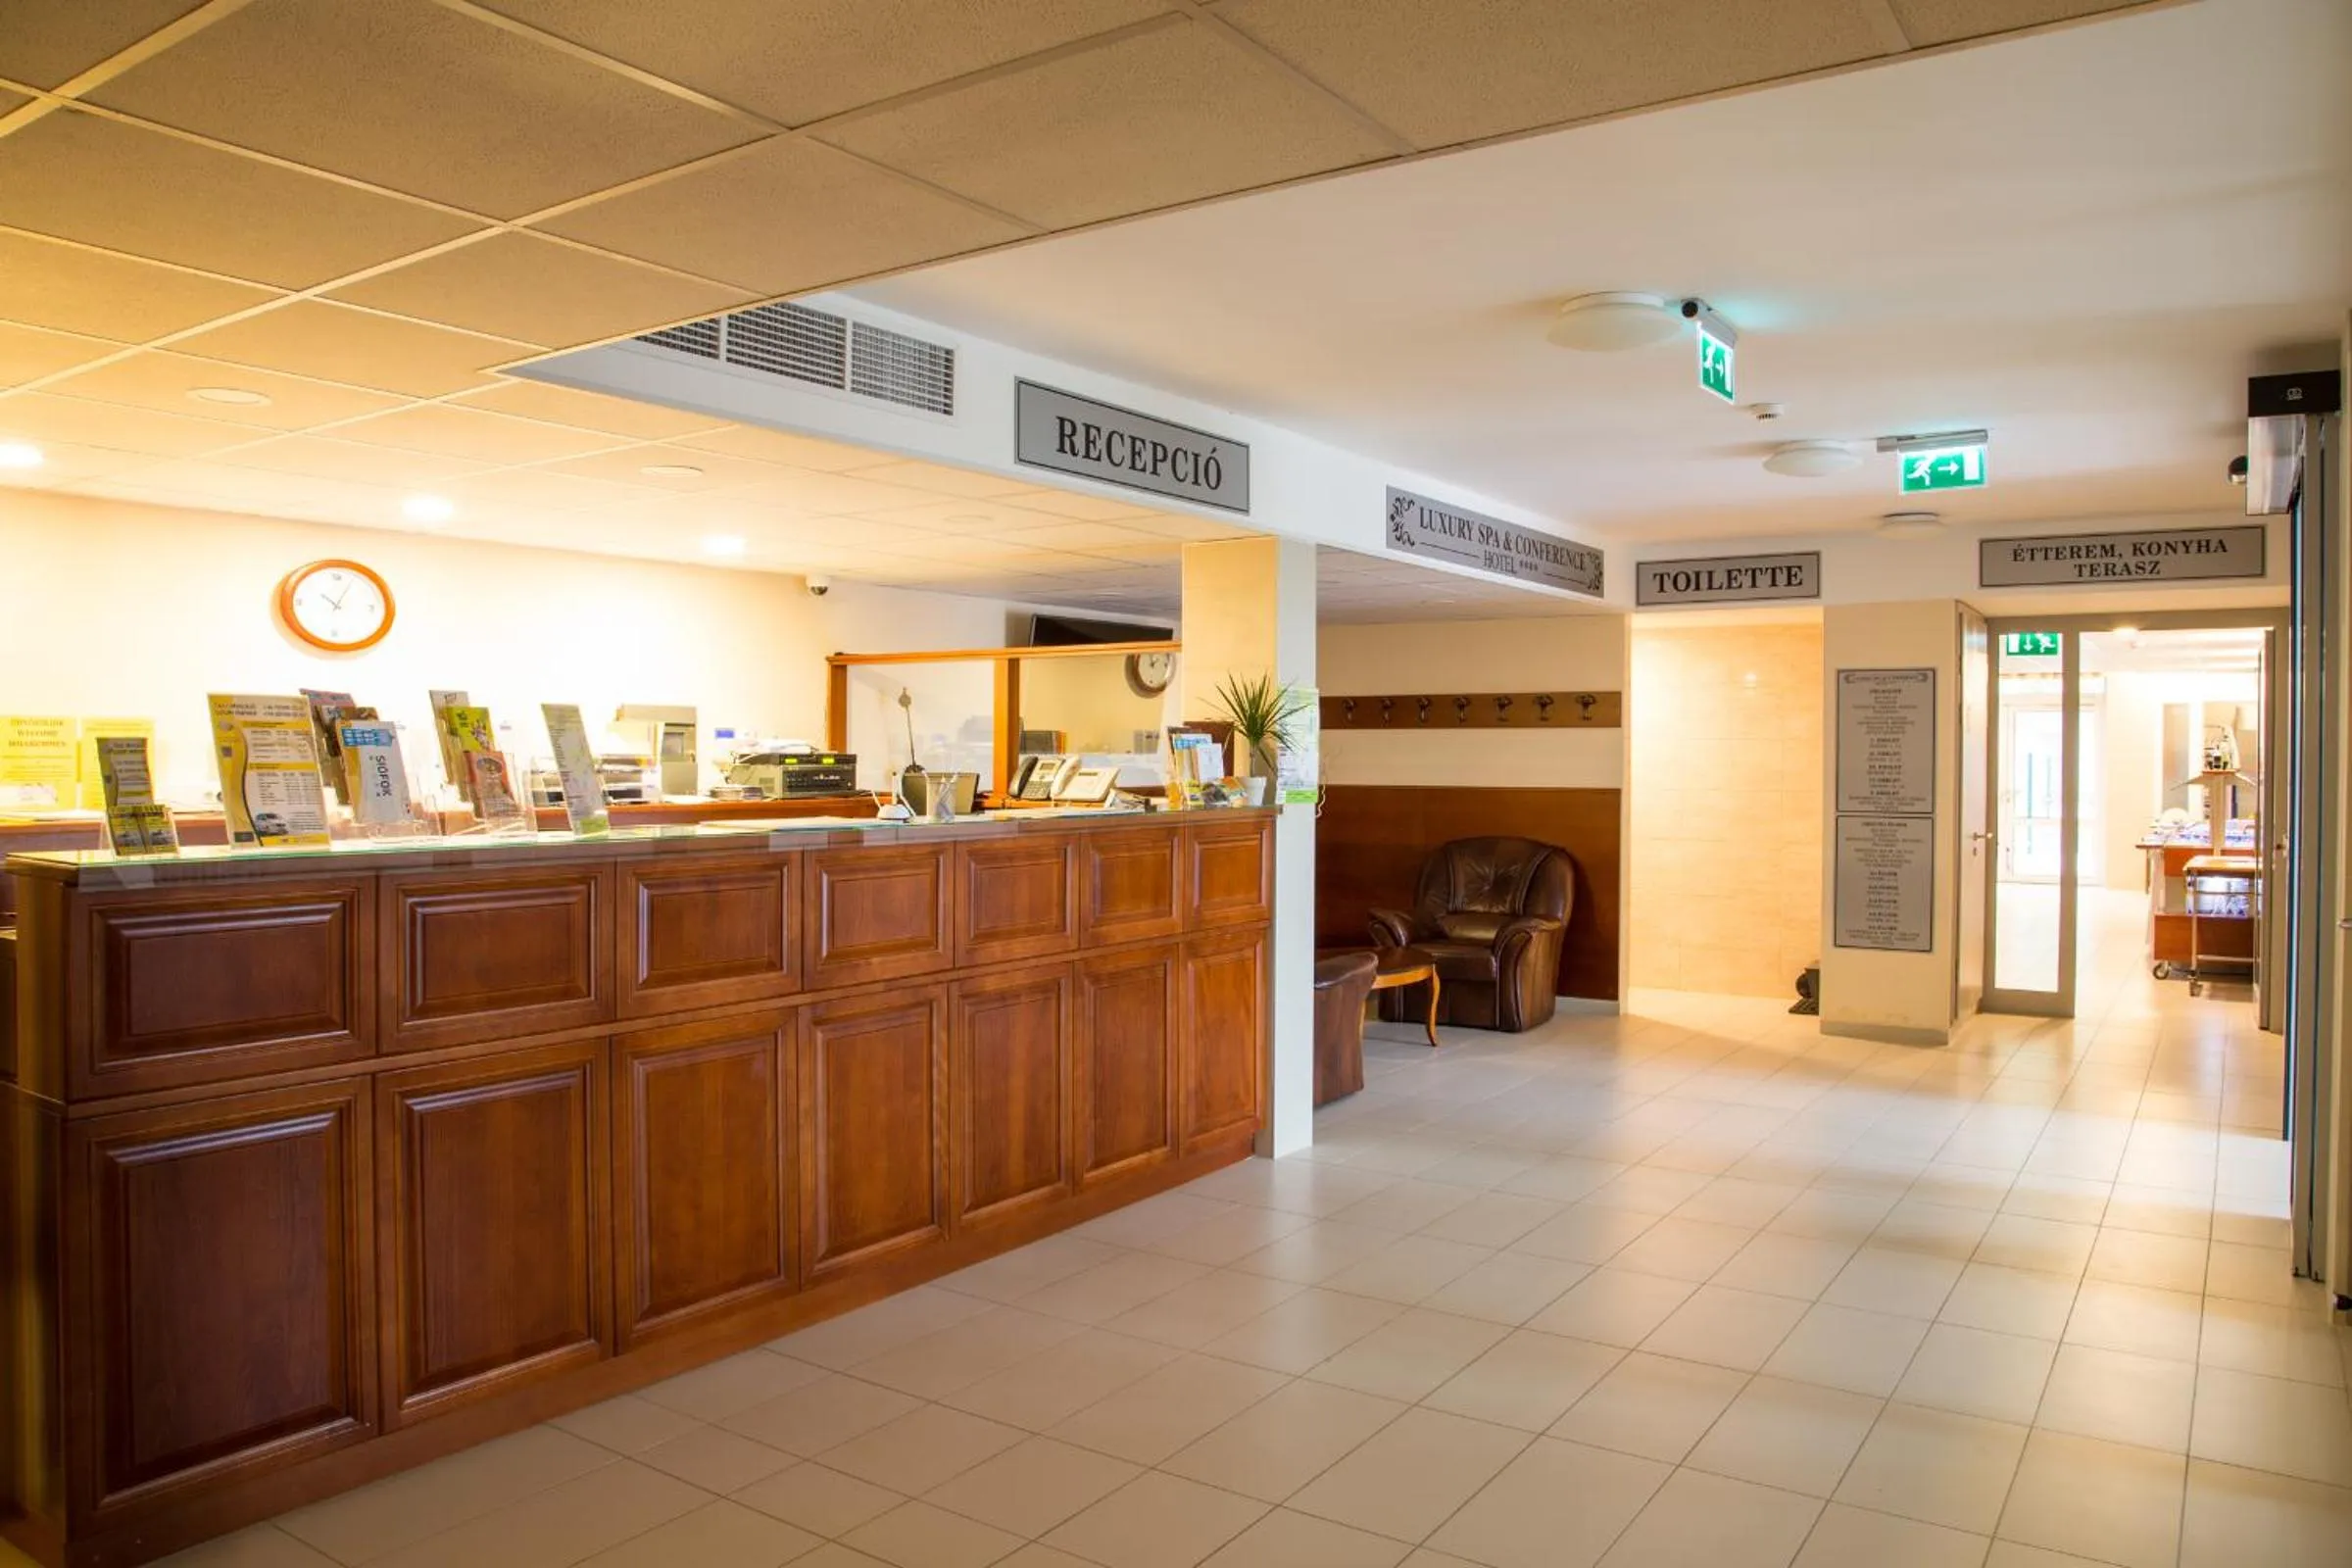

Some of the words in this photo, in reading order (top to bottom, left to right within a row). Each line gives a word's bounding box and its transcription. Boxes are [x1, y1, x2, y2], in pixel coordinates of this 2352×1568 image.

[1054, 415, 1222, 491] RECEPCIÓ
[1419, 506, 1474, 542] LUXURY
[1478, 522, 1500, 549] SPA
[1503, 530, 1512, 551] &
[1515, 533, 1586, 571] CONFERENCE
[2012, 543, 2123, 563] ÉTTEREM,
[2132, 538, 2229, 557] KONYHA
[1483, 549, 1517, 574] HOTEL
[2074, 561, 2161, 578] TERASZ
[1652, 564, 1803, 594] TOILETTE
